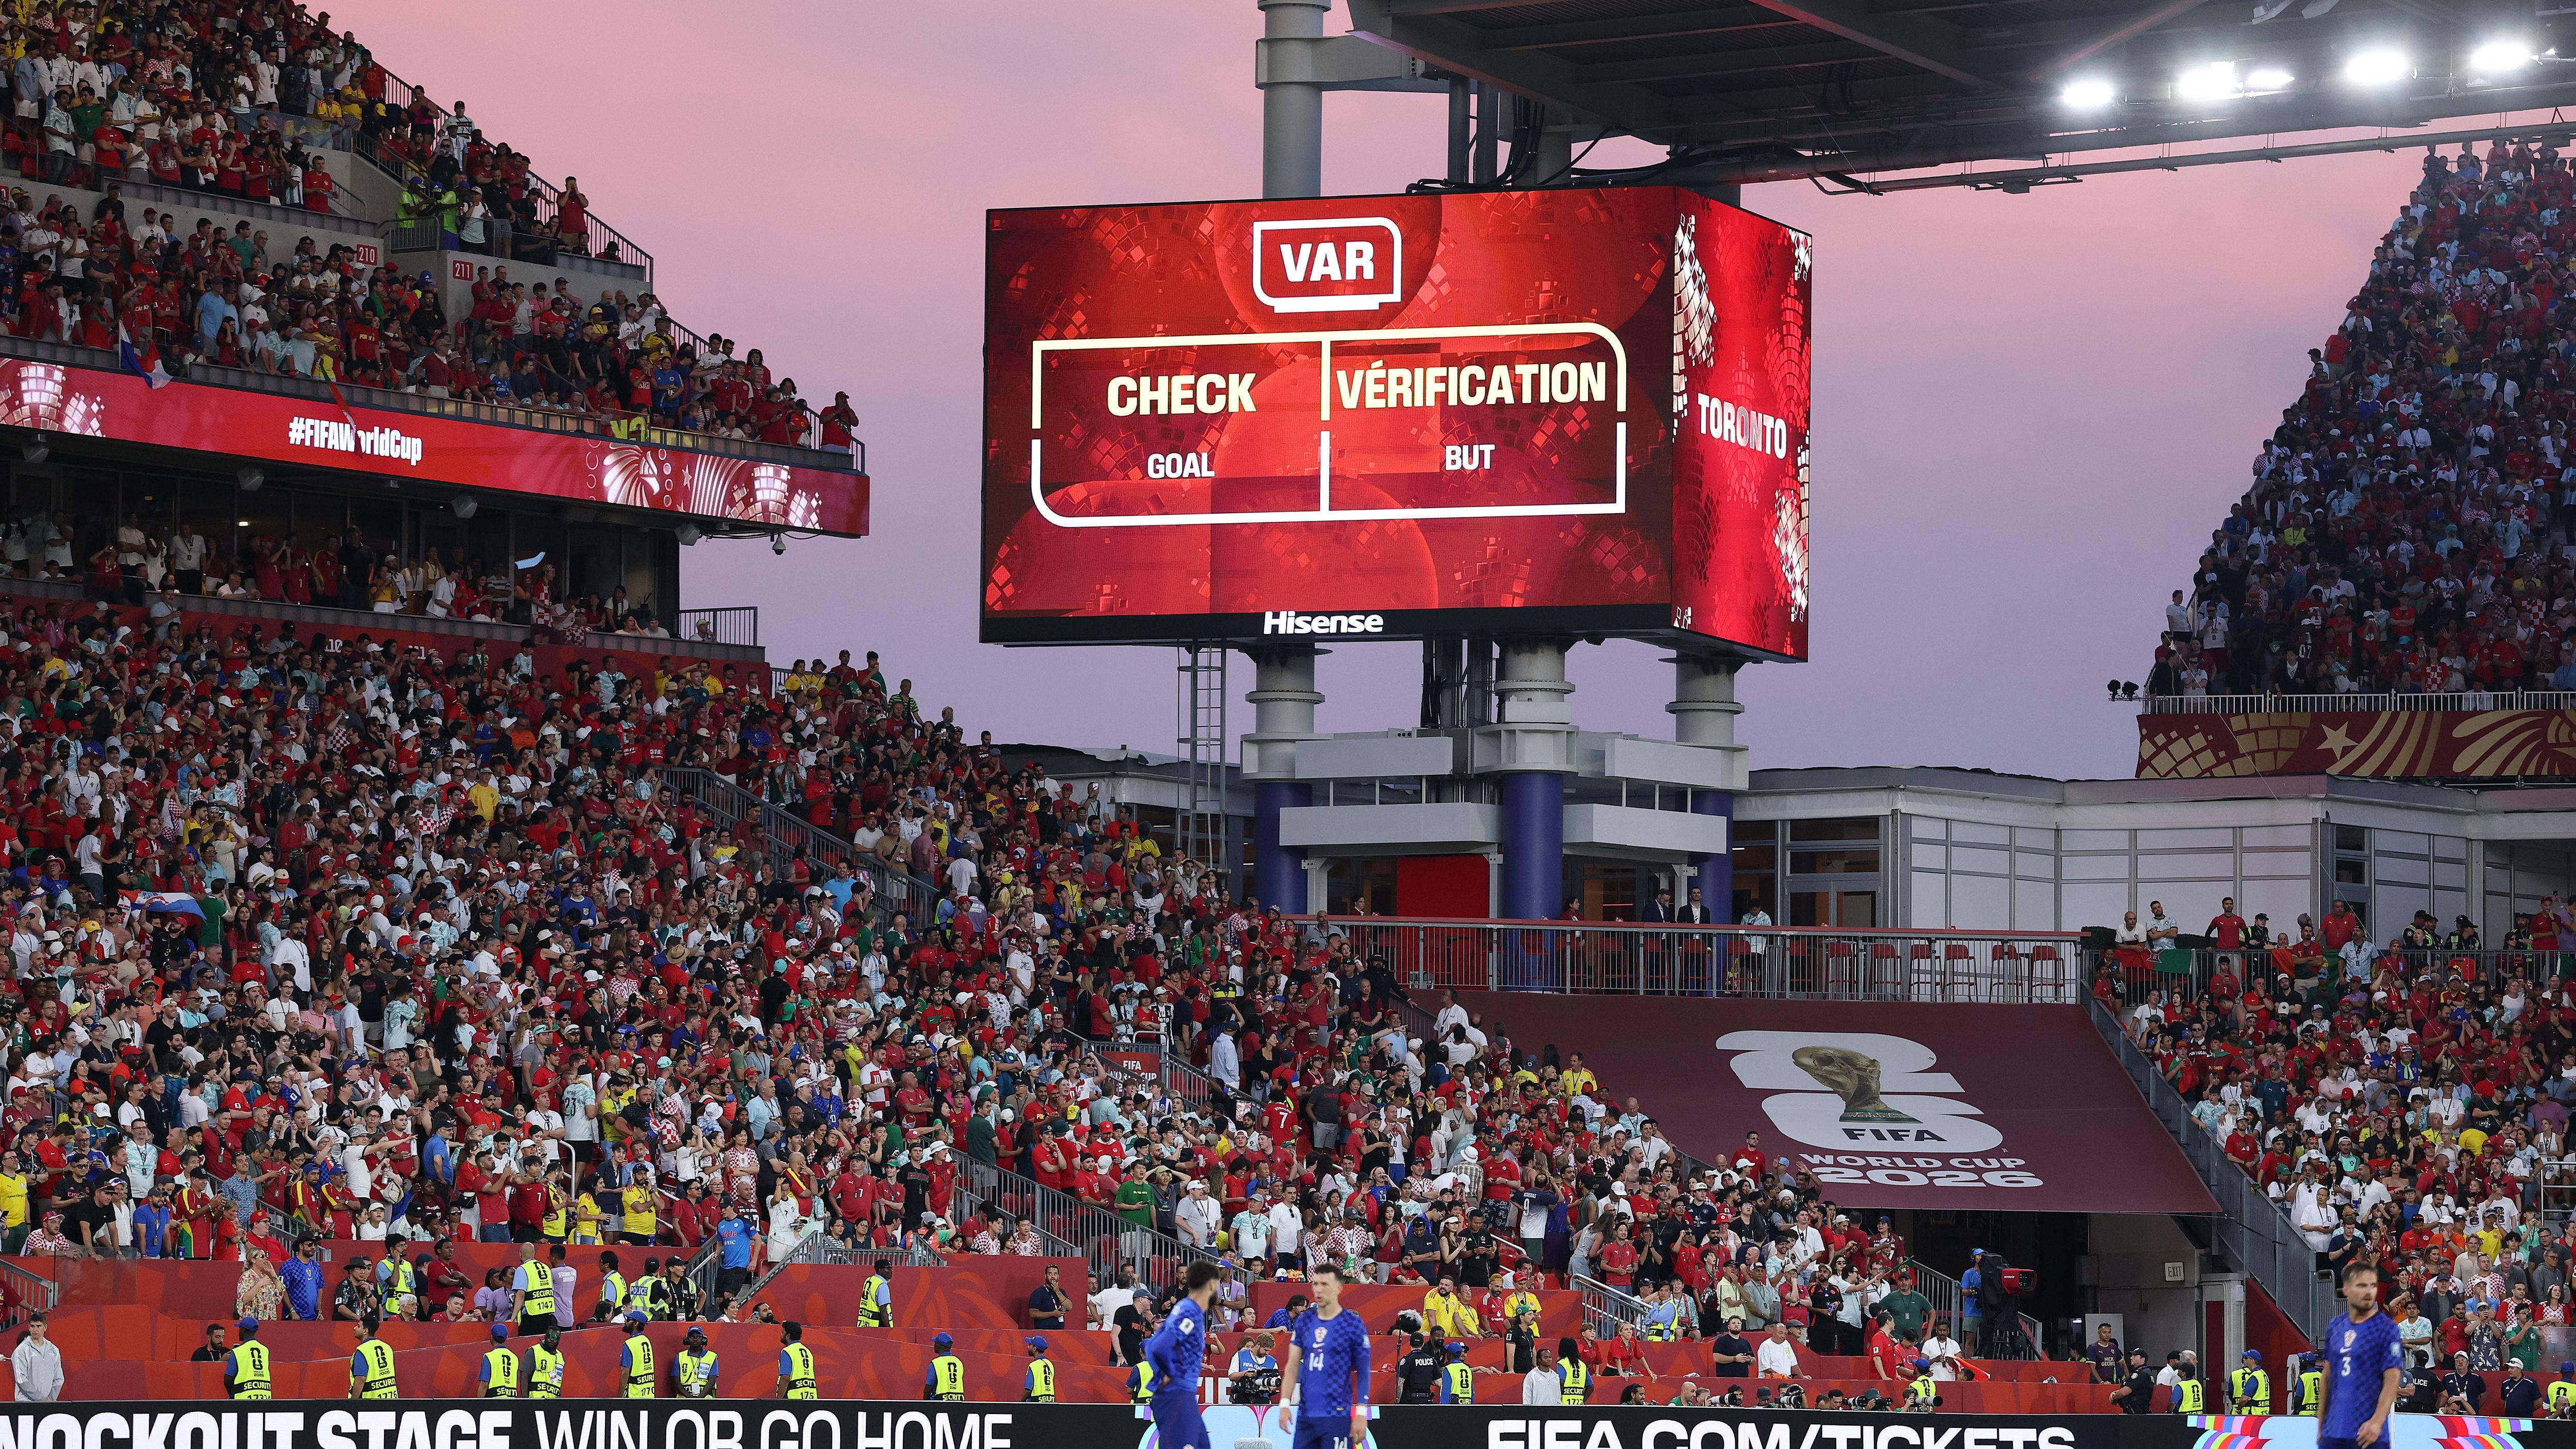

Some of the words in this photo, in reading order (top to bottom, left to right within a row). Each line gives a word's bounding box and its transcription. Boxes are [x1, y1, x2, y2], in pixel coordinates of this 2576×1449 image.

[359, 247, 374, 262] 210
[1280, 241, 1374, 283] VAR
[455, 263, 469, 278] 211
[1337, 360, 1607, 410] VÉRIFICATION
[1107, 373, 1256, 417] CHECK
[1697, 393, 1788, 460] TORONTO
[289, 416, 422, 465] #FIFAWorldCup
[1445, 444, 1495, 471] BUT
[1147, 452, 1216, 479] GOAL
[299, 579, 302, 587] 7
[1264, 611, 1384, 634] Hisense
[430, 746, 437, 755] 26
[1123, 1060, 1142, 1070] FIFA
[873, 1074, 880, 1084] 10
[1279, 1112, 1287, 1128] 7
[1841, 1128, 1947, 1142] FIFA
[1798, 1153, 1943, 1168] WORLD
[1948, 1157, 2026, 1169] CUP
[932, 1173, 936, 1182] 7
[1812, 1167, 2044, 1188] 2026
[537, 1192, 542, 1201] 7
[858, 1188, 863, 1197] 7
[1379, 1194, 1386, 1202] 13
[1569, 1195, 1573, 1204] 7
[1522, 1198, 1529, 1216] 9
[693, 1215, 697, 1224] 7
[2168, 1266, 2182, 1277] EXIT
[630, 1286, 647, 1295] POLICE
[537, 1301, 552, 1310] 1747
[1309, 1352, 1325, 1371] 14
[1415, 1358, 1433, 1366] POLICE
[2341, 1356, 2351, 1376] 3
[377, 1390, 397, 1399] 1776
[317, 1411, 512, 1449] STAGE
[534, 1411, 647, 1449] WIN
[666, 1410, 745, 1449] OR
[760, 1409, 841, 1449] GO
[857, 1412, 1013, 1449] HOME
[1333, 1437, 1348, 1449] 14
